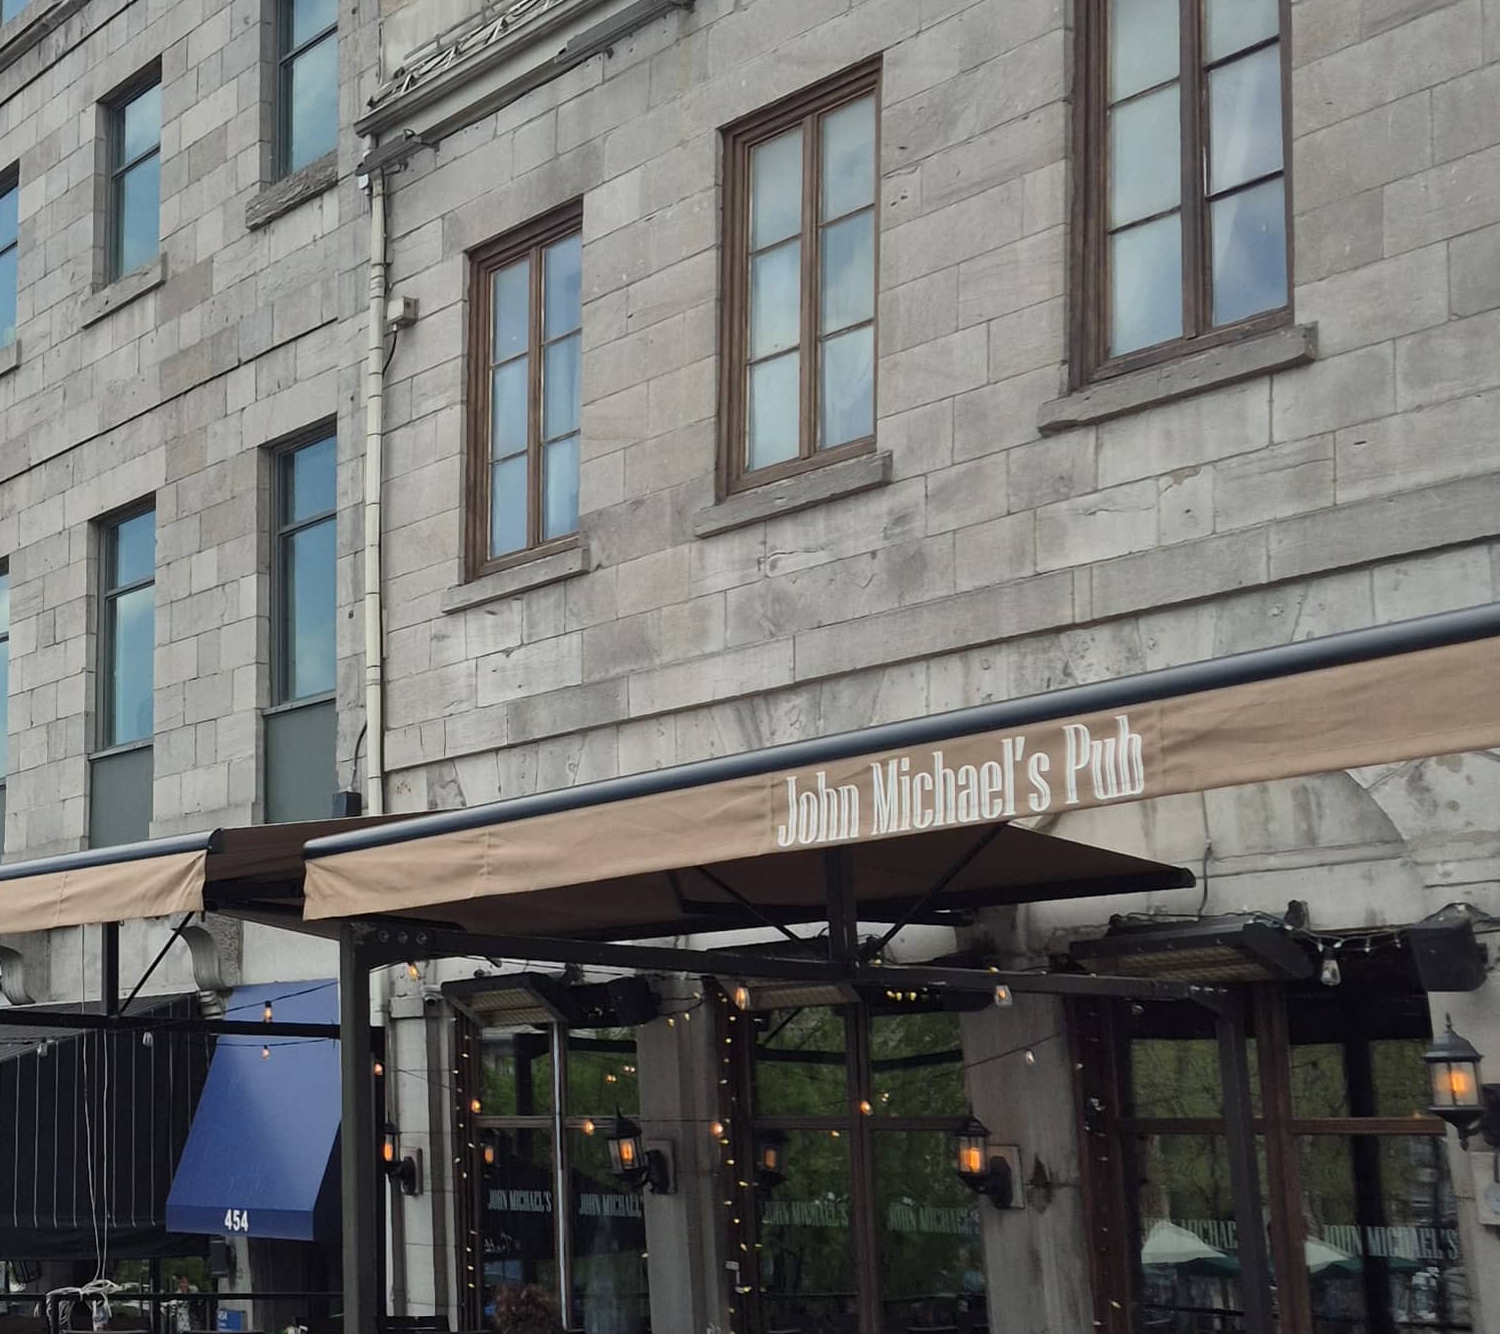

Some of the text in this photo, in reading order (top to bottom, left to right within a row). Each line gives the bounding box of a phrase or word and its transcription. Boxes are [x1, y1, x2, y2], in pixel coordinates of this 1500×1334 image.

[777, 714, 1145, 848] John Michael's Pub
[224, 1208, 249, 1232] 454
